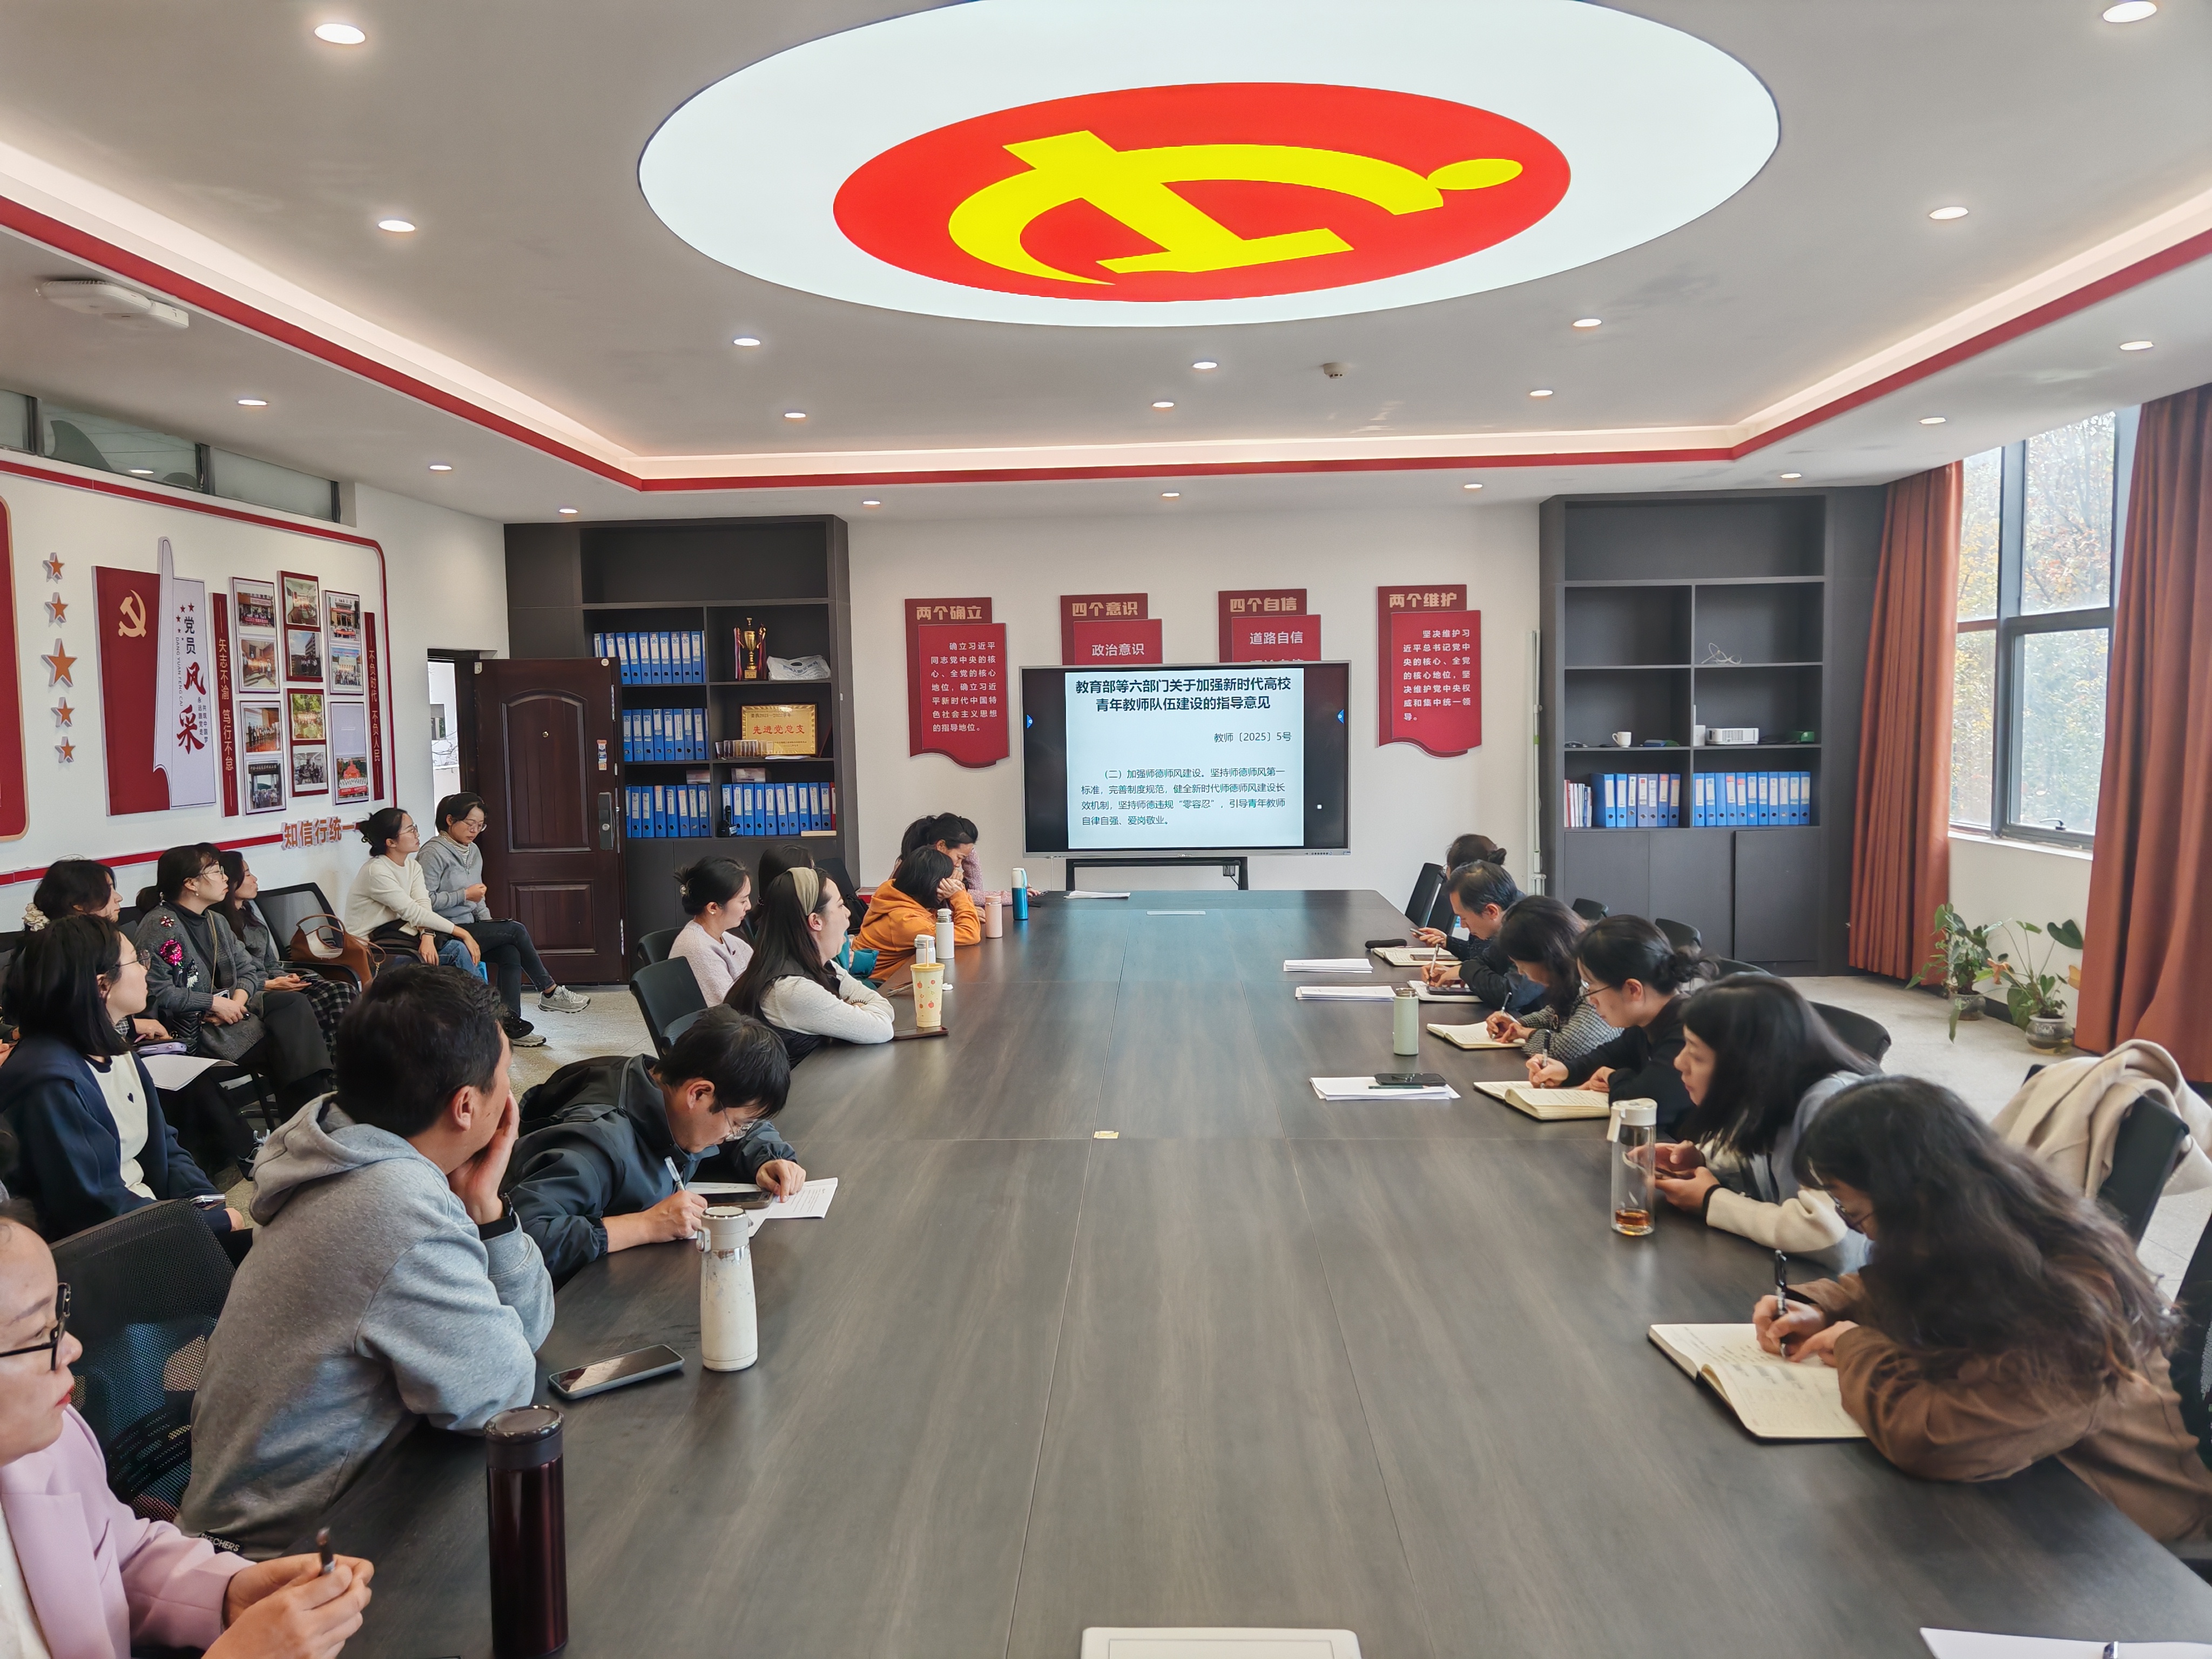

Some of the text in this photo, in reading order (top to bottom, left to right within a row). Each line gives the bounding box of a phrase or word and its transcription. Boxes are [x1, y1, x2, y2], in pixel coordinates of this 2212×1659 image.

[1230, 597, 1297, 612] 四个自信
[1389, 592, 1457, 608] 两个维护
[916, 605, 982, 621] 两个确立
[1072, 601, 1138, 617] 四个意识
[1250, 631, 1304, 645] 道路自信
[1422, 630, 1470, 638] 坚决维护习
[949, 642, 996, 651] 确立习近平
[1091, 643, 1144, 657] 政治意识
[1403, 643, 1470, 652] 近平总书记党中
[930, 655, 996, 665] 同志党中央的核
[1403, 657, 1471, 666] 央的核心、全党
[931, 669, 996, 678] 心、全党的核心
[1403, 670, 1471, 680] 的核心地位，坚
[932, 683, 997, 692] 地位，确立习近
[1075, 676, 1291, 694] 教育部等六部门关于加强新时代高校
[1403, 684, 1471, 693] 决维护党中央权
[219, 638, 234, 771] 矢志不渝 笃行不怠
[932, 696, 997, 705] 平新时代中国特
[1096, 695, 1271, 712] 青年教师队伍建设的指导意见
[1404, 697, 1471, 707] 威和集中统一领
[369, 650, 380, 762] 不负时代 不负人民
[932, 710, 997, 719] 色社会主义思想
[1404, 712, 1418, 721] 导。
[752, 724, 805, 735] 先进党总支
[933, 724, 981, 732] 的指导地位。
[1082, 815, 1170, 826] 自律自强、爱岗敬业。
[283, 817, 355, 848] 知信行统一
[201, 1533, 240, 1552] SKECHERS
